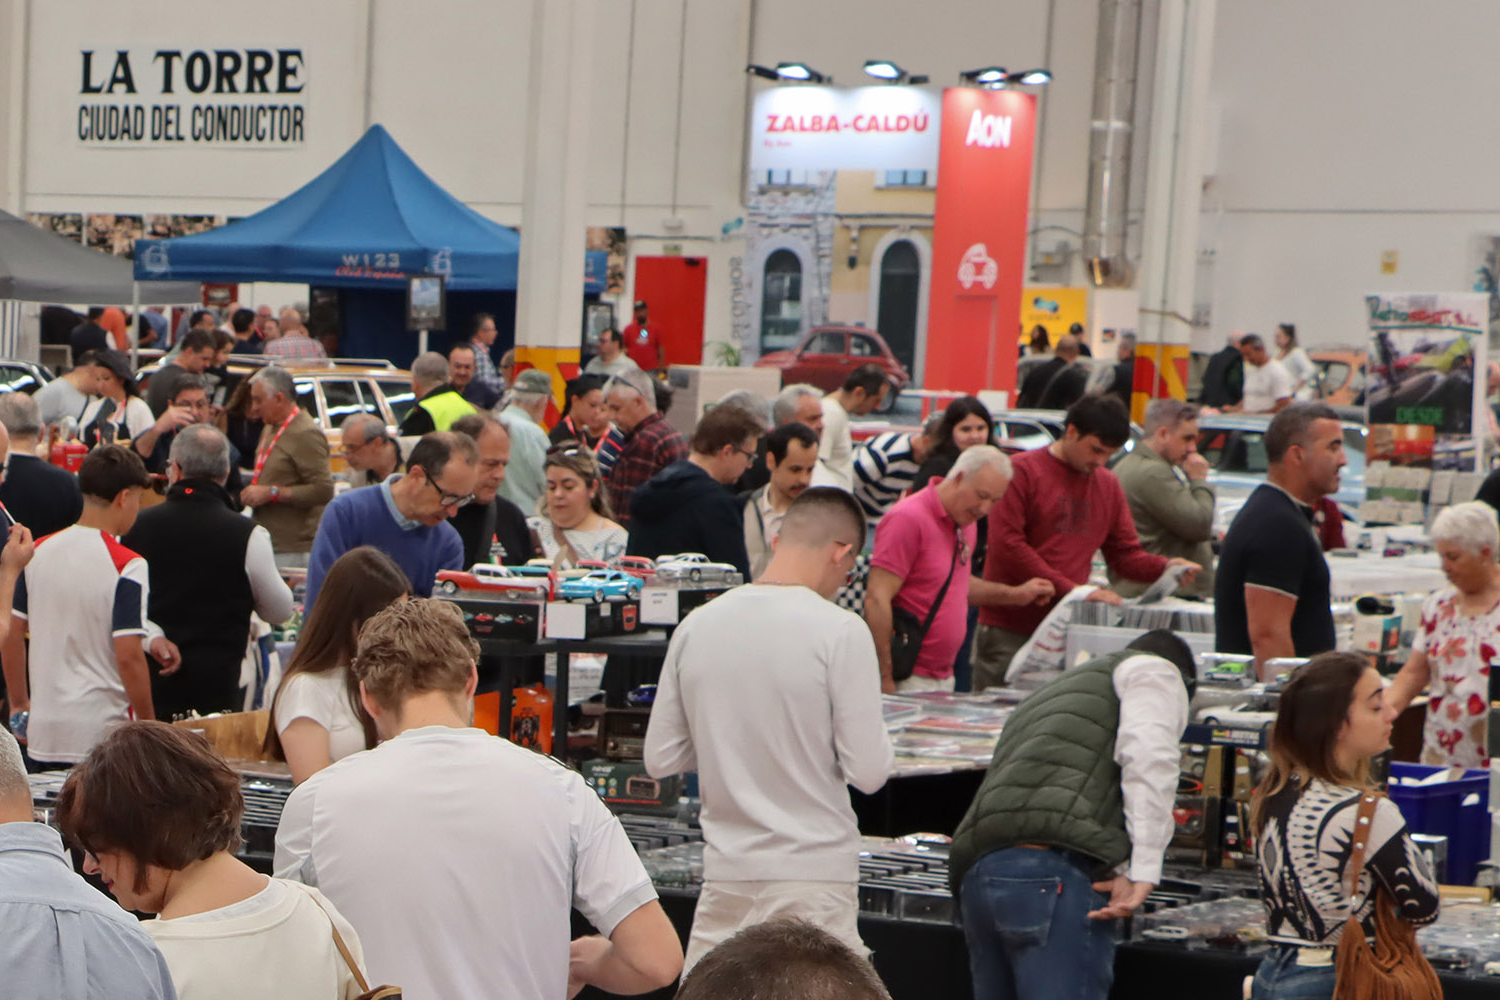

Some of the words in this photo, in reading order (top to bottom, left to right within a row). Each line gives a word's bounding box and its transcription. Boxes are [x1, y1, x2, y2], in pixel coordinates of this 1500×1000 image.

[79, 49, 138, 94] LA
[152, 49, 306, 94] TORRE
[78, 104, 145, 141] CIUDAD
[151, 104, 185, 141] DEL
[191, 104, 305, 142] CONDUCTOR
[765, 110, 930, 133] ZALBA-CALDÚ
